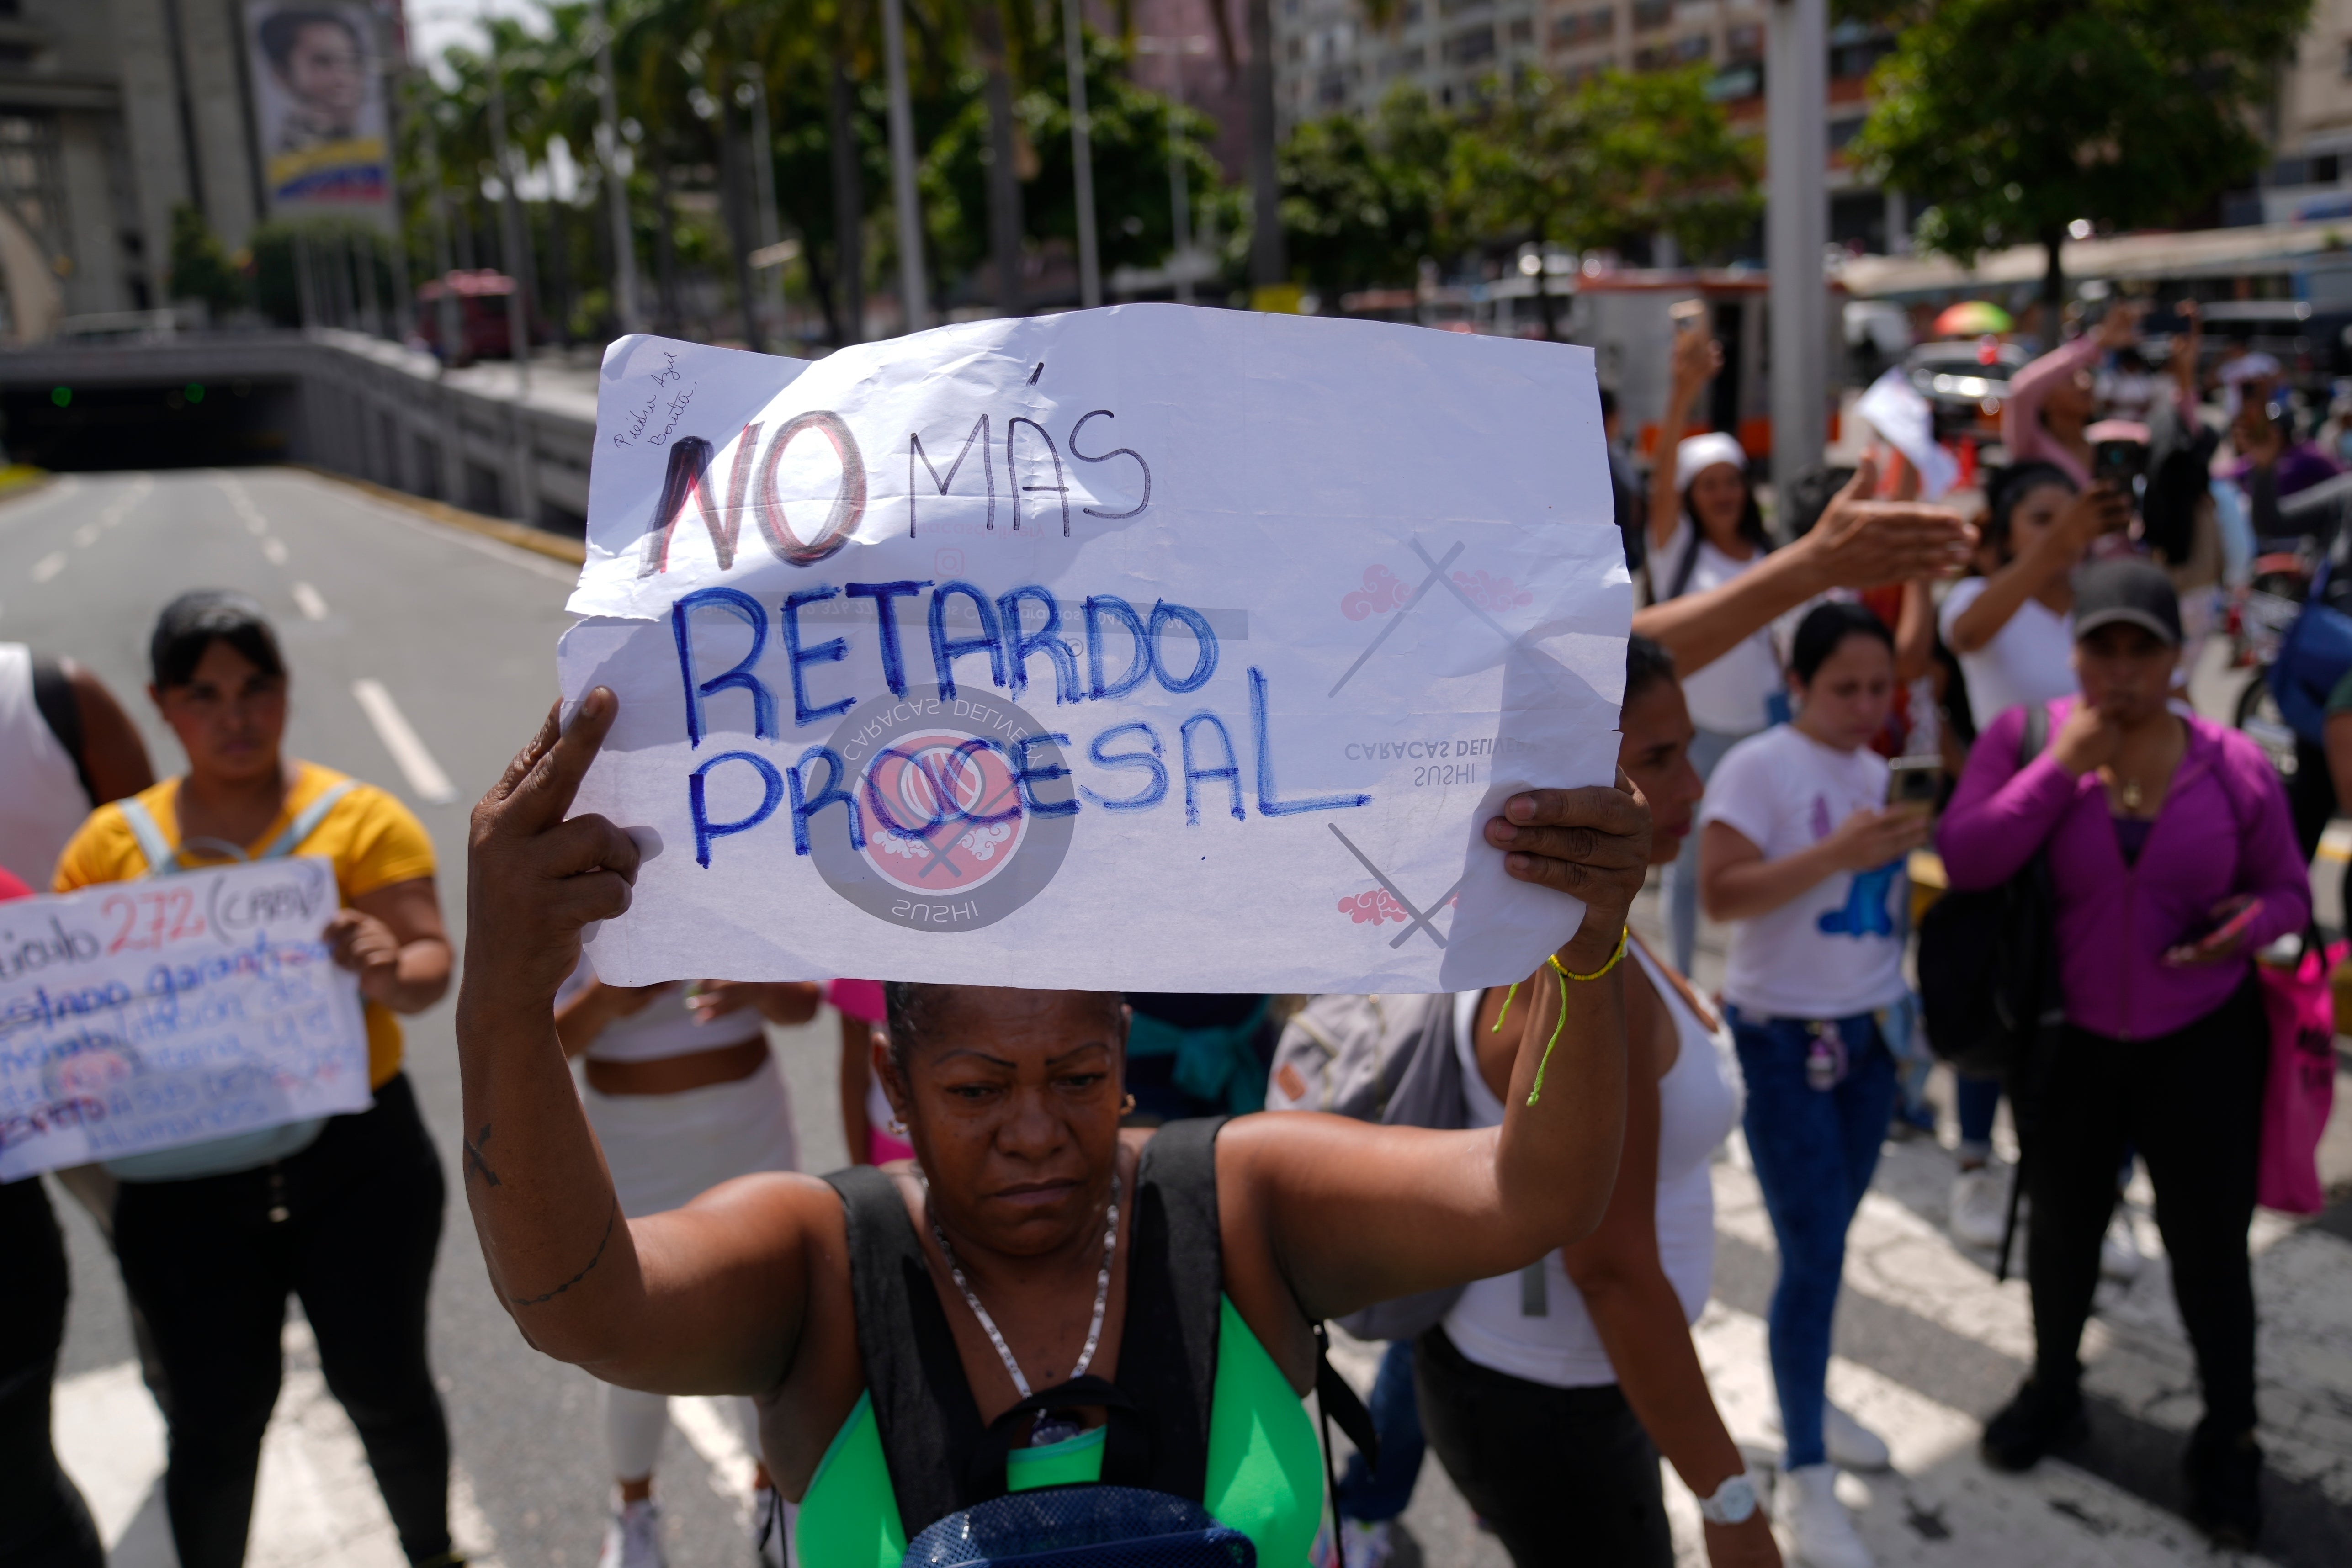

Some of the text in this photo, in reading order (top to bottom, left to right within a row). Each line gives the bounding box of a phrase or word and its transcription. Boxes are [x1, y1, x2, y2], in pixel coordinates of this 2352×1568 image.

[639, 362, 1152, 578] NO MÁS
[673, 580, 1220, 751] RETARDO
[689, 665, 1374, 869] PROCESAL
[102, 887, 207, 955] 272
